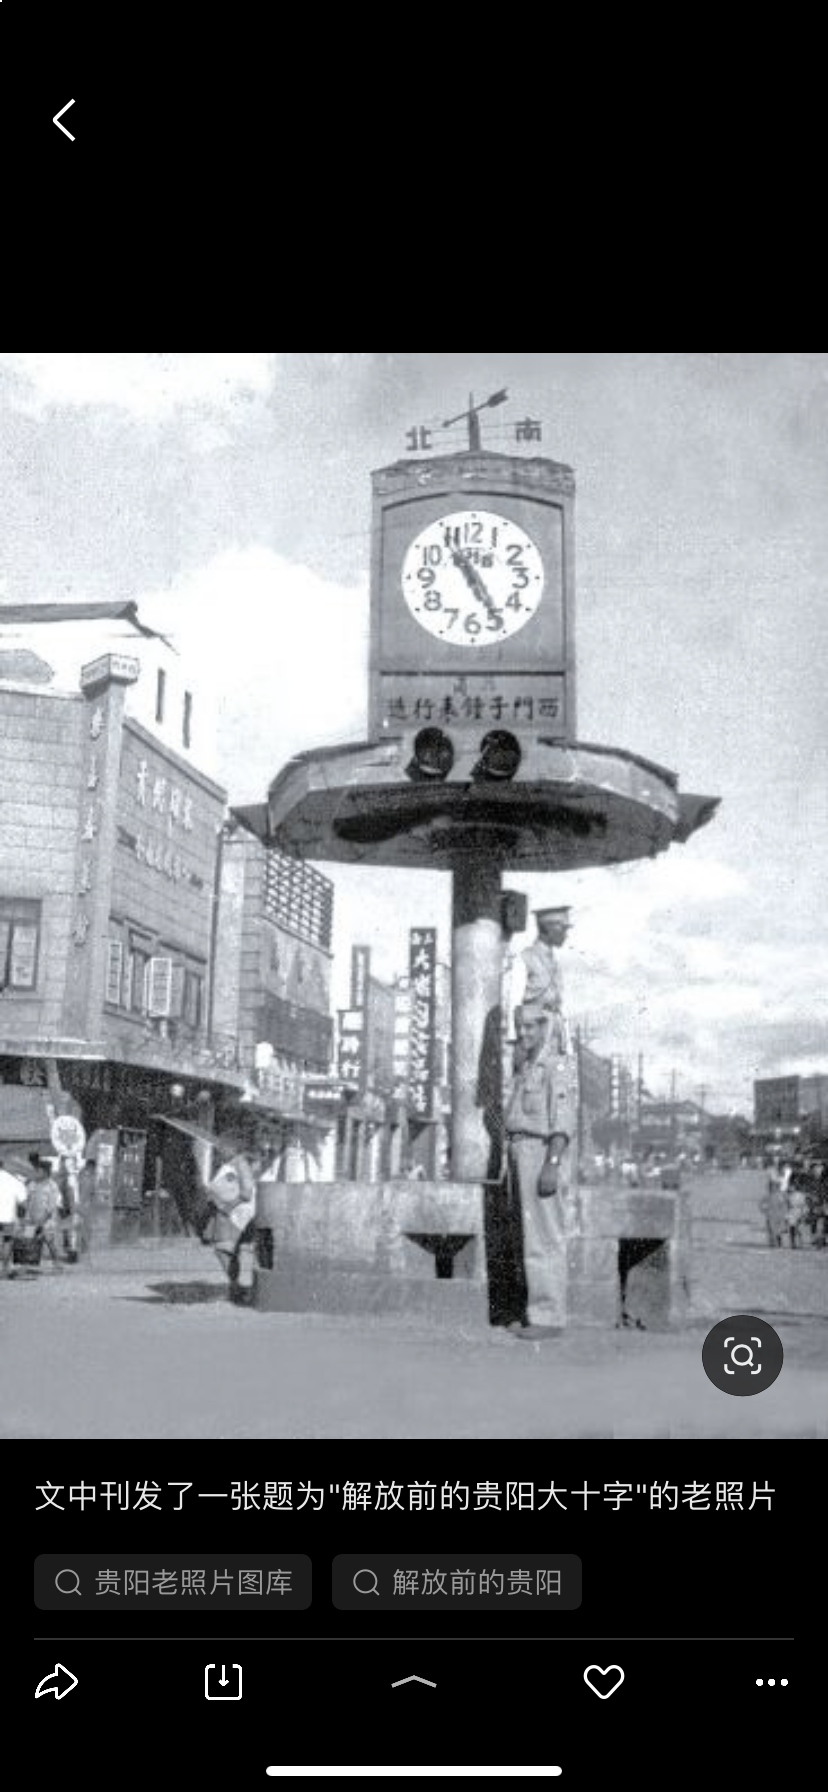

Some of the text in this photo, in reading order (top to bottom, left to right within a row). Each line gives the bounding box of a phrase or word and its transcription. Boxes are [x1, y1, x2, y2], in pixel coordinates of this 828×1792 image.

[405, 425, 432, 451] 北
[515, 416, 542, 442] 南
[464, 522, 483, 544] 12
[491, 526, 498, 548] 1
[423, 545, 442, 566] 10
[505, 544, 524, 566] 2
[417, 567, 436, 589] 9
[511, 567, 530, 589] 3
[423, 590, 442, 611] 8
[505, 591, 523, 613] 4
[444, 608, 459, 629] 7
[464, 612, 482, 635] 6
[485, 608, 504, 632] 5
